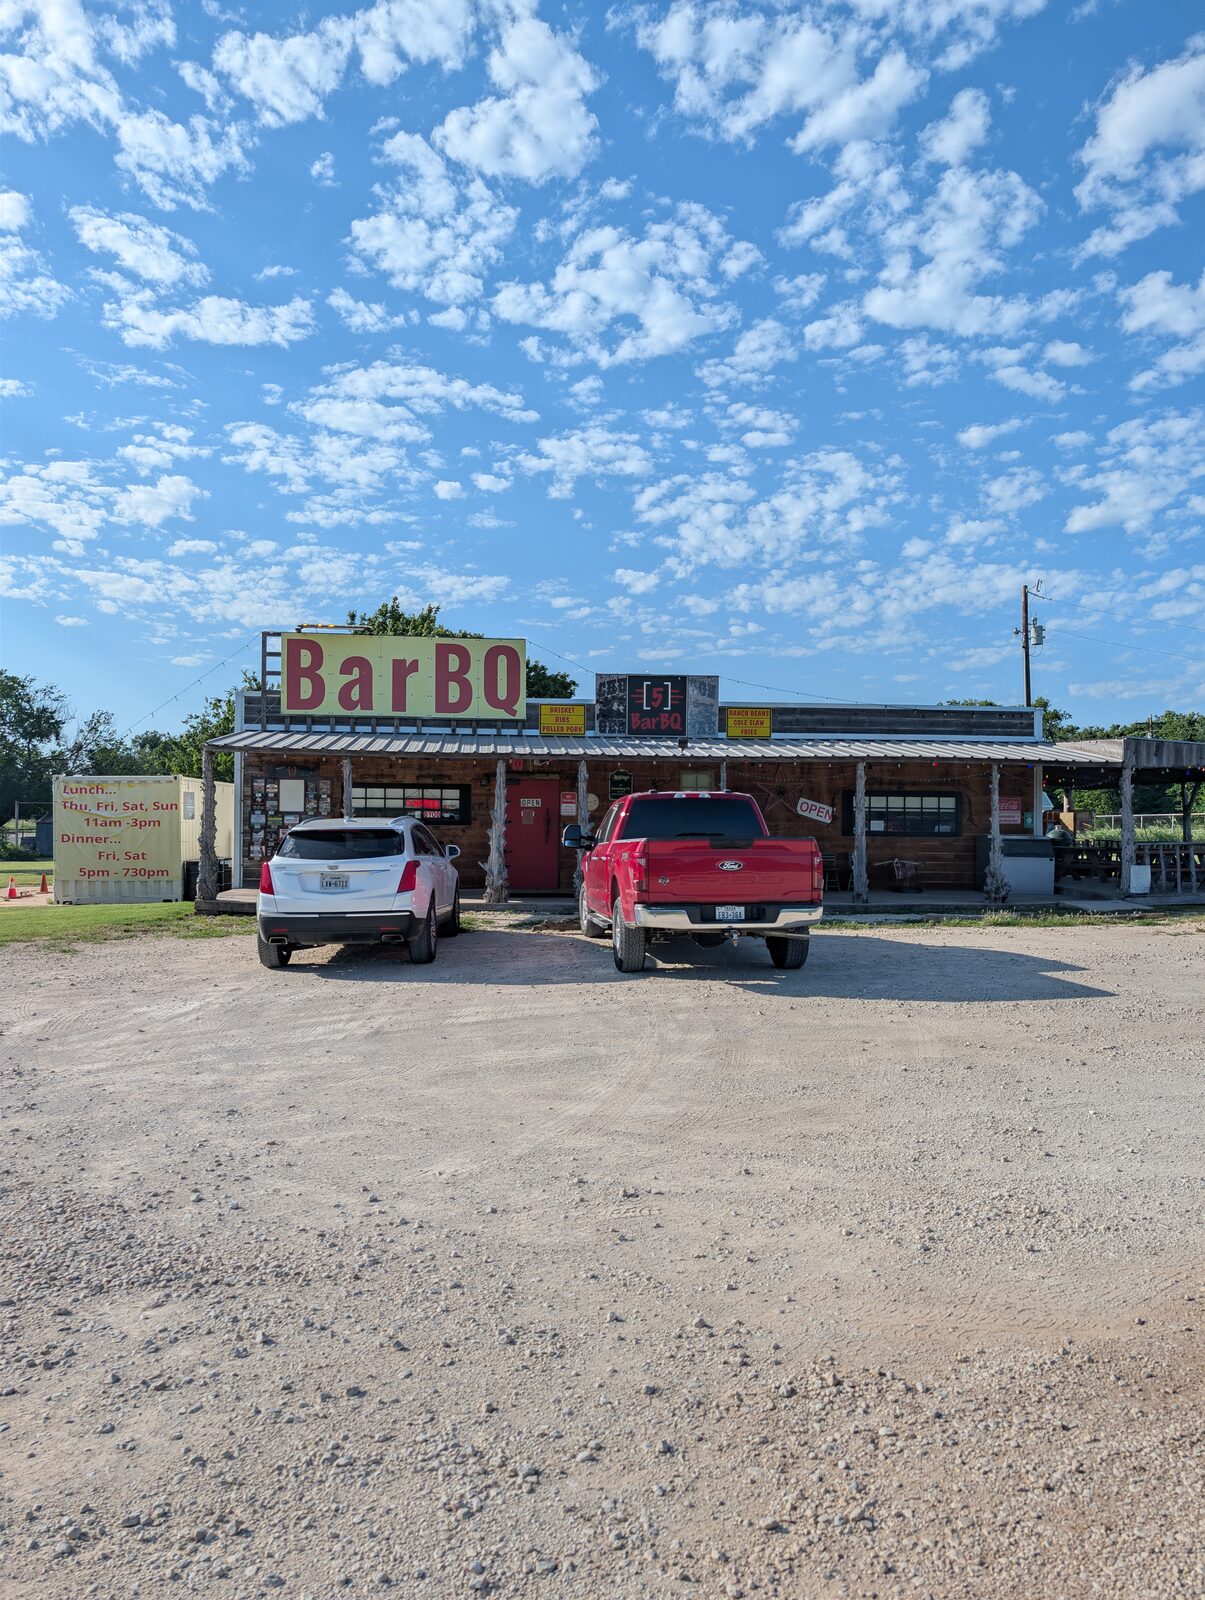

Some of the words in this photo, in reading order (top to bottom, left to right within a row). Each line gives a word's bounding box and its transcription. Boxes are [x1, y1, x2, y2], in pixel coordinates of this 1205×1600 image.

[286, 638, 521, 717] BarBQ
[549, 706, 576, 714] BRISKET
[728, 709, 749, 717] RANCH
[750, 709, 769, 717] BEANS
[630, 712, 682, 731] BarBQ
[542, 724, 565, 732] PULLED
[566, 725, 583, 733] PORK
[740, 728, 758, 736] FRIES
[62, 784, 117, 795] Lunch...
[61, 800, 92, 812] Thu,
[96, 801, 118, 812] Fri,
[122, 801, 148, 812] Sat,
[152, 801, 178, 811] Sun
[521, 799, 540, 807] OPEN
[799, 801, 832, 821] OPEN
[83, 817, 122, 827] 11am
[126, 818, 161, 829] -3pm
[60, 833, 121, 844] Dinner...
[98, 851, 120, 862] Fri,
[124, 851, 147, 861] Sat
[79, 867, 110, 879] 5pm
[123, 867, 169, 879] 730pm
